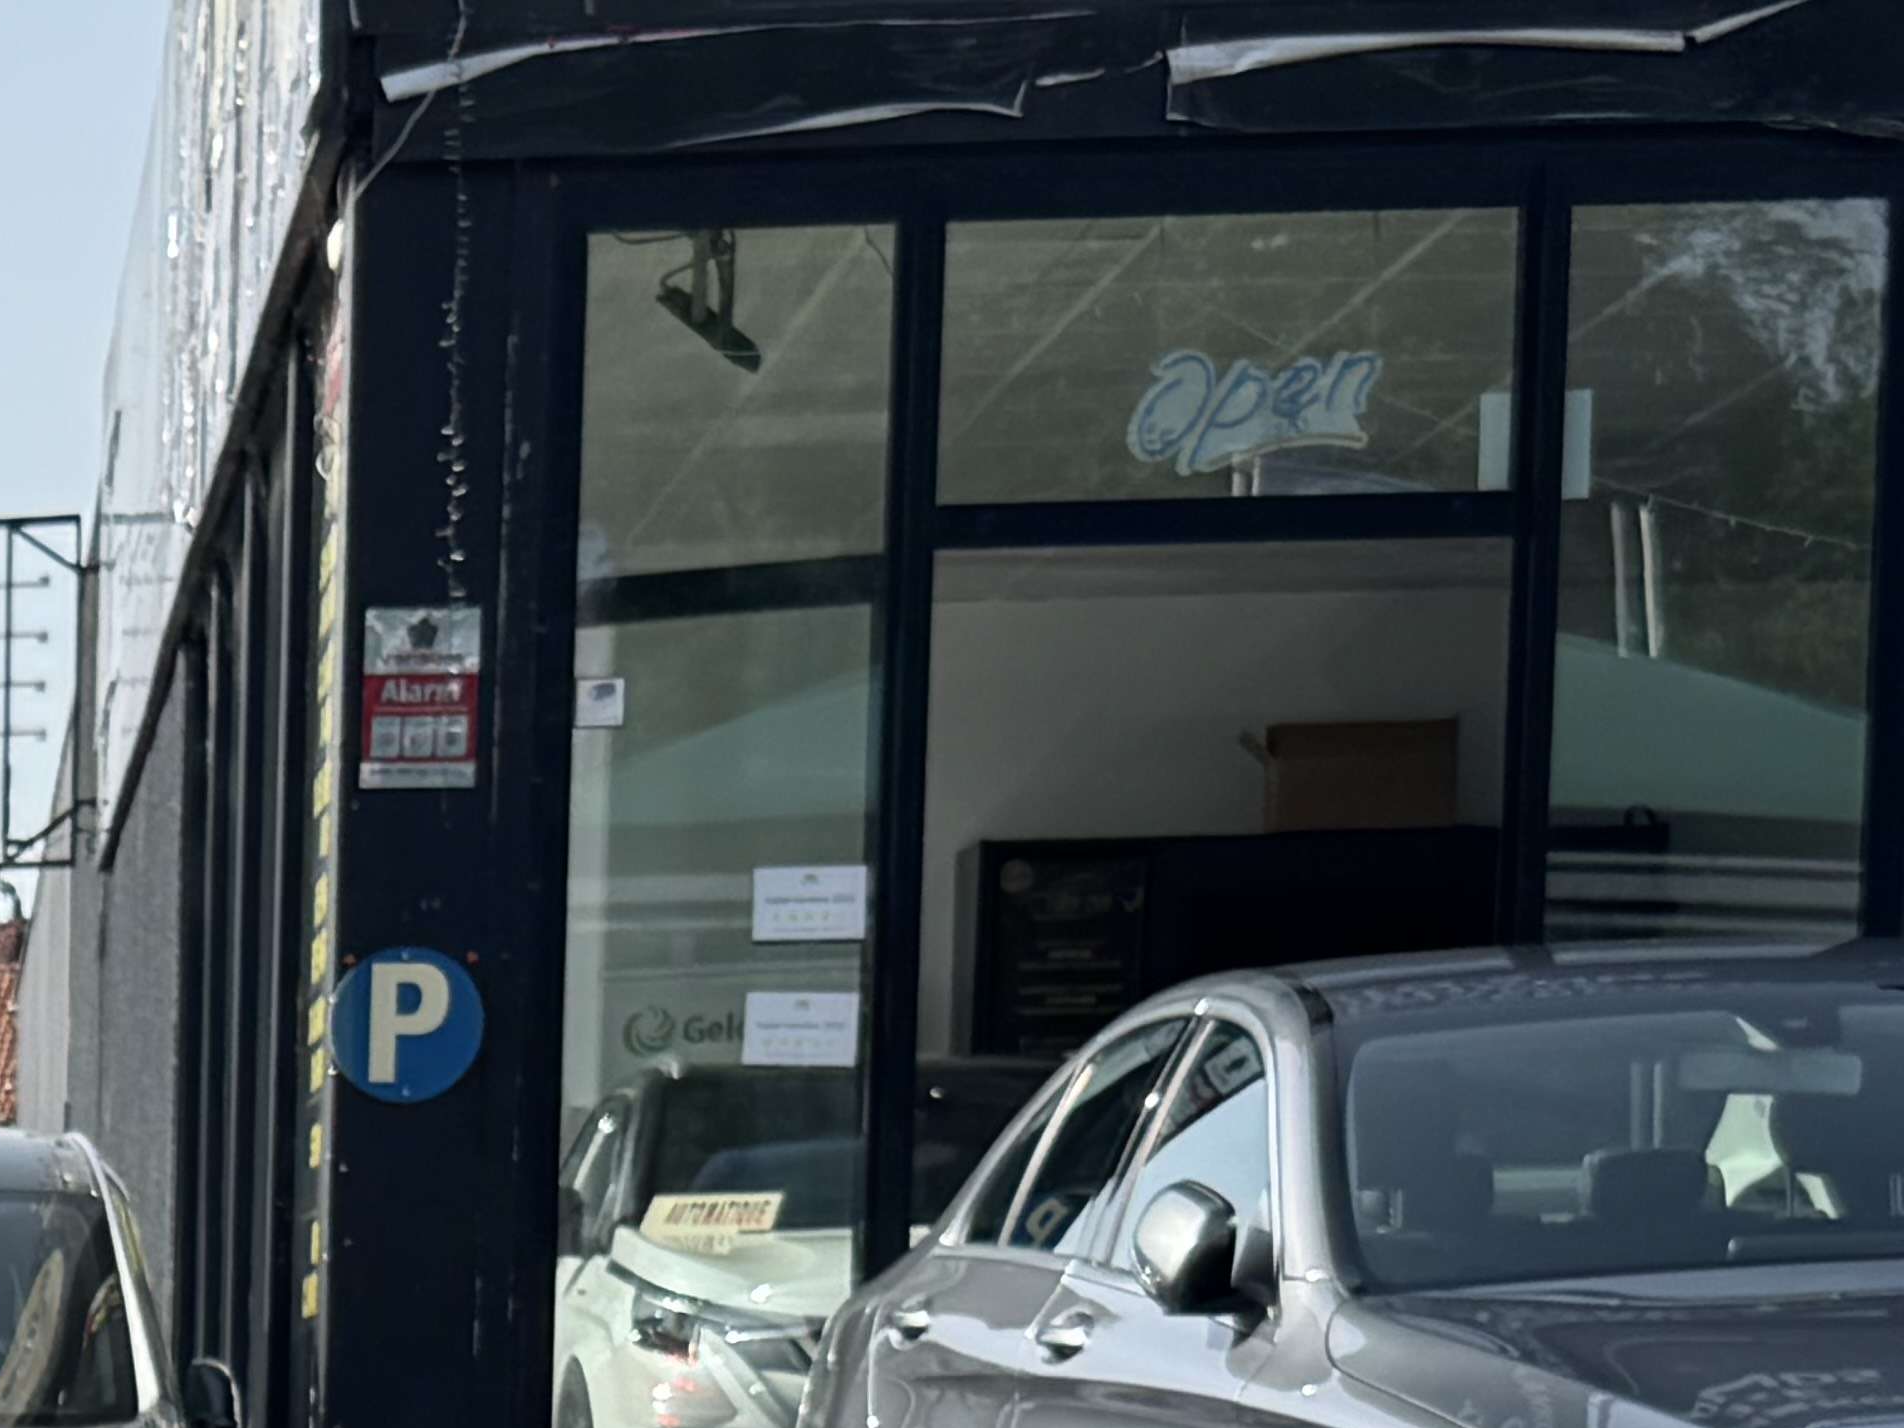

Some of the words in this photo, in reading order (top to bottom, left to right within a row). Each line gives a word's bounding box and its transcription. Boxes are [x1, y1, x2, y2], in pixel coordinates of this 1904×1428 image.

[1131, 350, 1381, 472] Open
[381, 680, 464, 703] Alarm
[368, 962, 450, 1083] P
